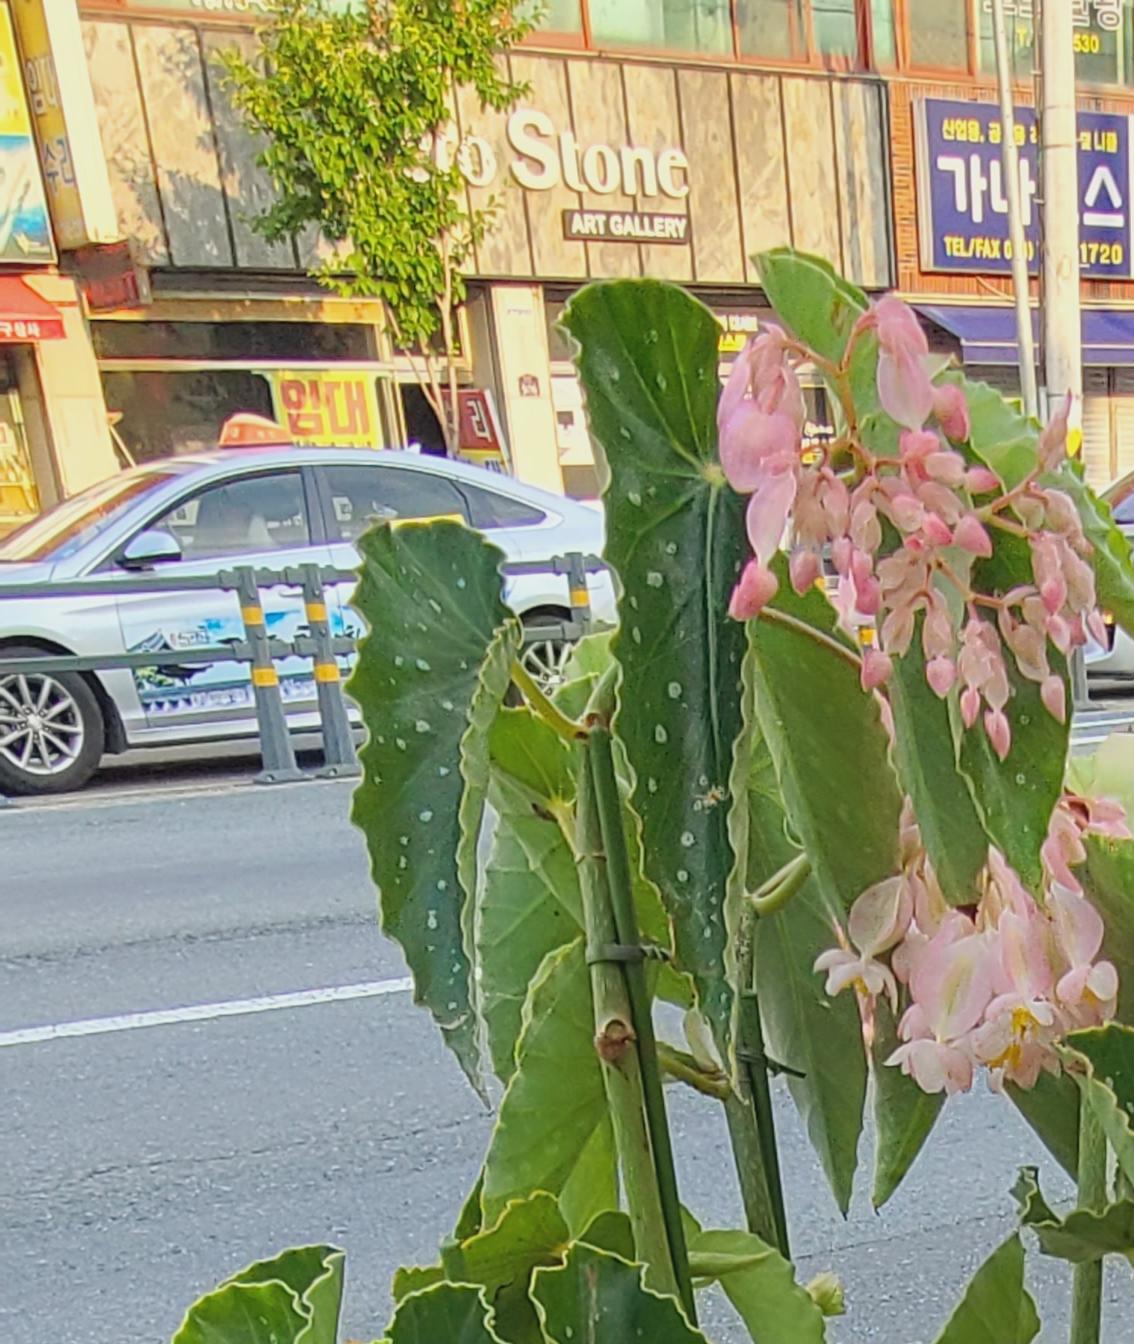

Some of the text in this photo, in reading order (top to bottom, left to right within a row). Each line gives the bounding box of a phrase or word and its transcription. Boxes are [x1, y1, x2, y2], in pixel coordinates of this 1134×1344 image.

[506, 108, 690, 199] Stone
[936, 153, 1125, 228] 가나스
[571, 212, 688, 238] ART GALLERY
[943, 235, 1001, 262] TEL/FAX
[280, 378, 371, 437] 임대
